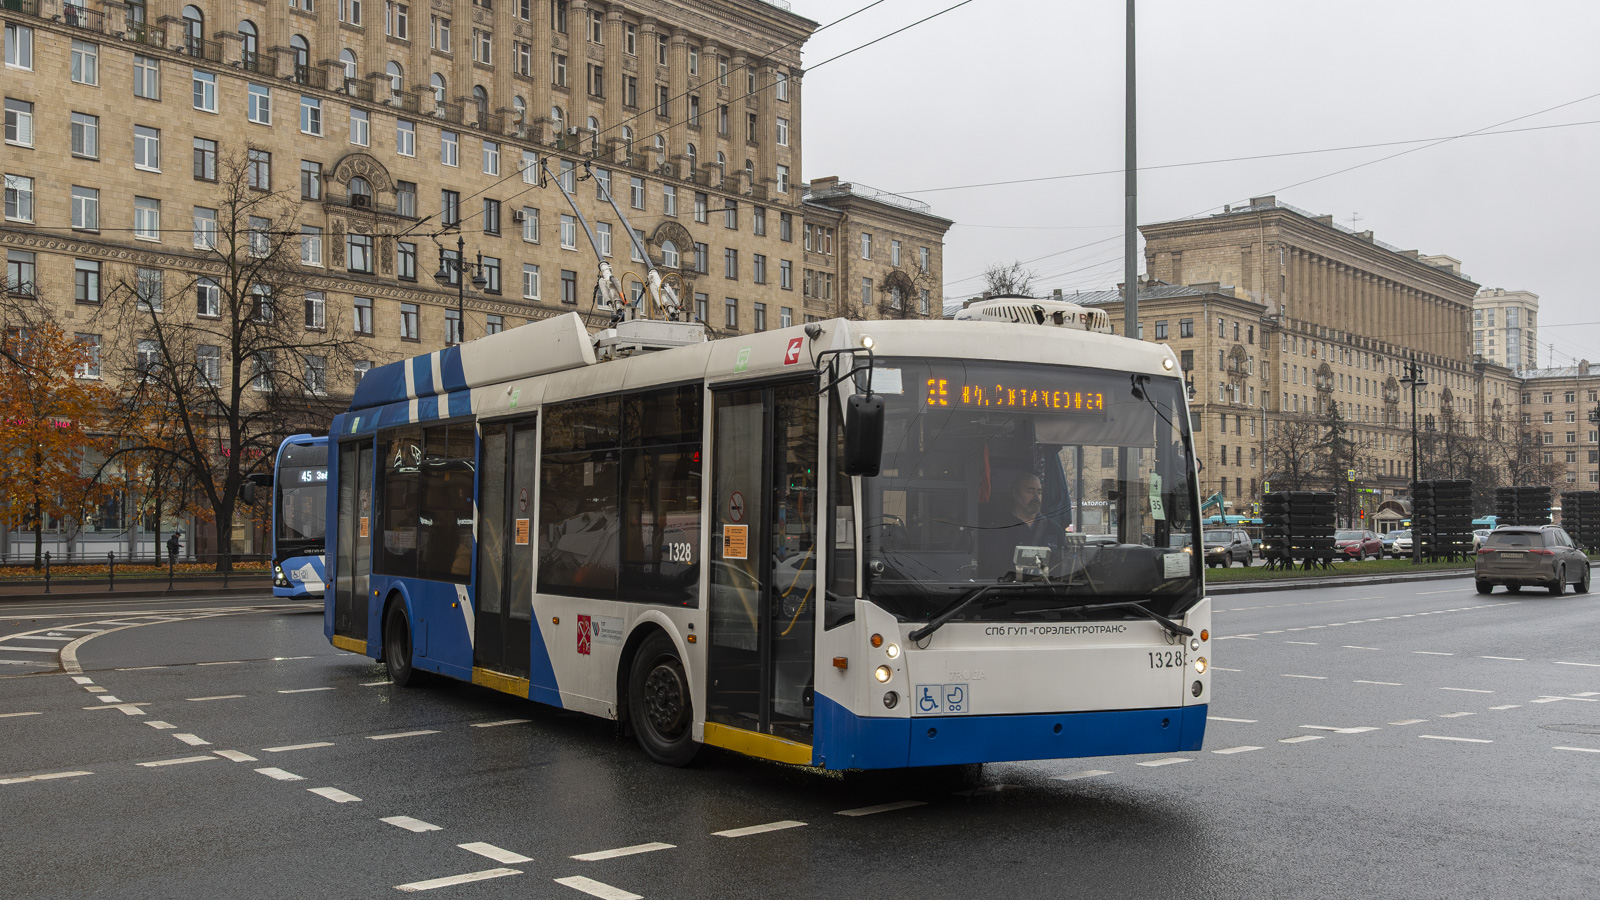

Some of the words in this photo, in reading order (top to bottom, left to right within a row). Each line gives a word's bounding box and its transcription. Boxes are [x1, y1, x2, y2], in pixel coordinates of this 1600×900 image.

[301, 470, 312, 482] 45
[1152, 500, 1161, 510] 35
[669, 542, 691, 562] 1328
[985, 626, 1005, 636] СПб
[1007, 626, 1028, 636] ГУП
[1029, 624, 1127, 635] «ГОРЭЛЕКТРОТРАНС»
[1148, 650, 1183, 669] 1328
